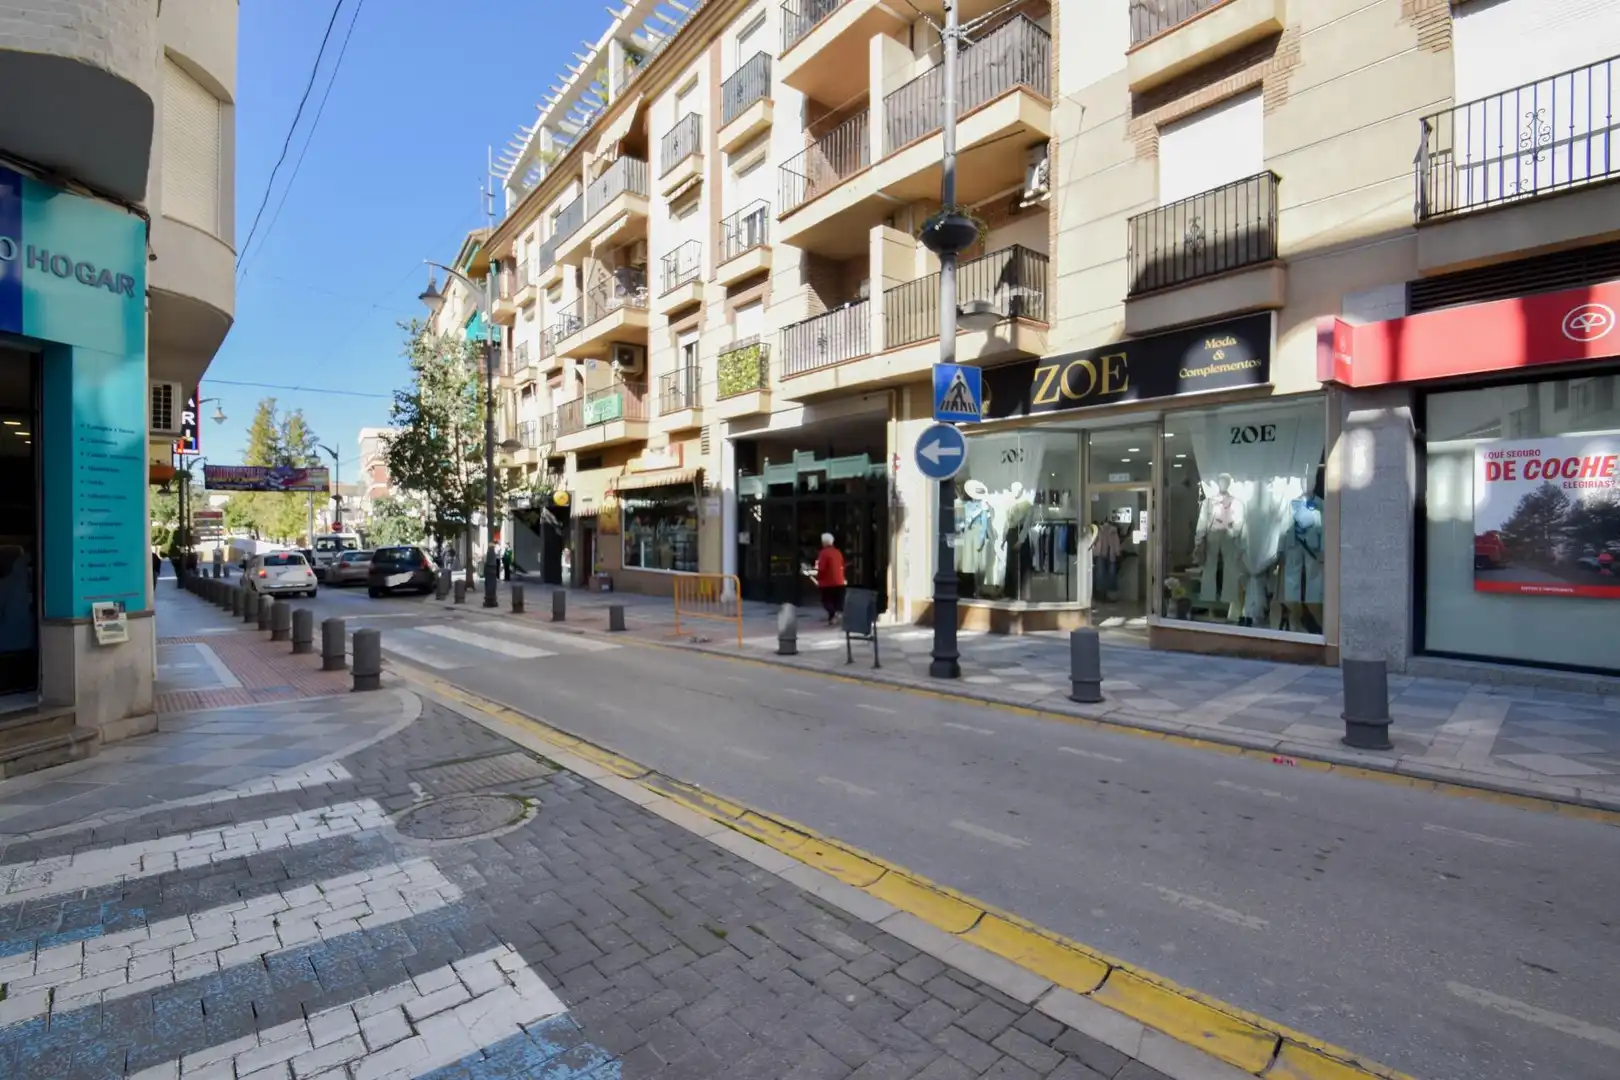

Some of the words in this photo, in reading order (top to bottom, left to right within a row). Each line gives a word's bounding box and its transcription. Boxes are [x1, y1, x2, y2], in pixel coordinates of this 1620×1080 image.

[26, 244, 136, 299] HOGAR
[1204, 336, 1237, 350] Moda
[1212, 349, 1225, 361] &
[1031, 352, 1129, 405] ZOE
[1179, 359, 1262, 379] Complementos
[1230, 424, 1276, 445] ZOE
[1506, 449, 1541, 458] SEGURO
[1485, 460, 1516, 482] DE
[1523, 455, 1618, 481] COCHE
